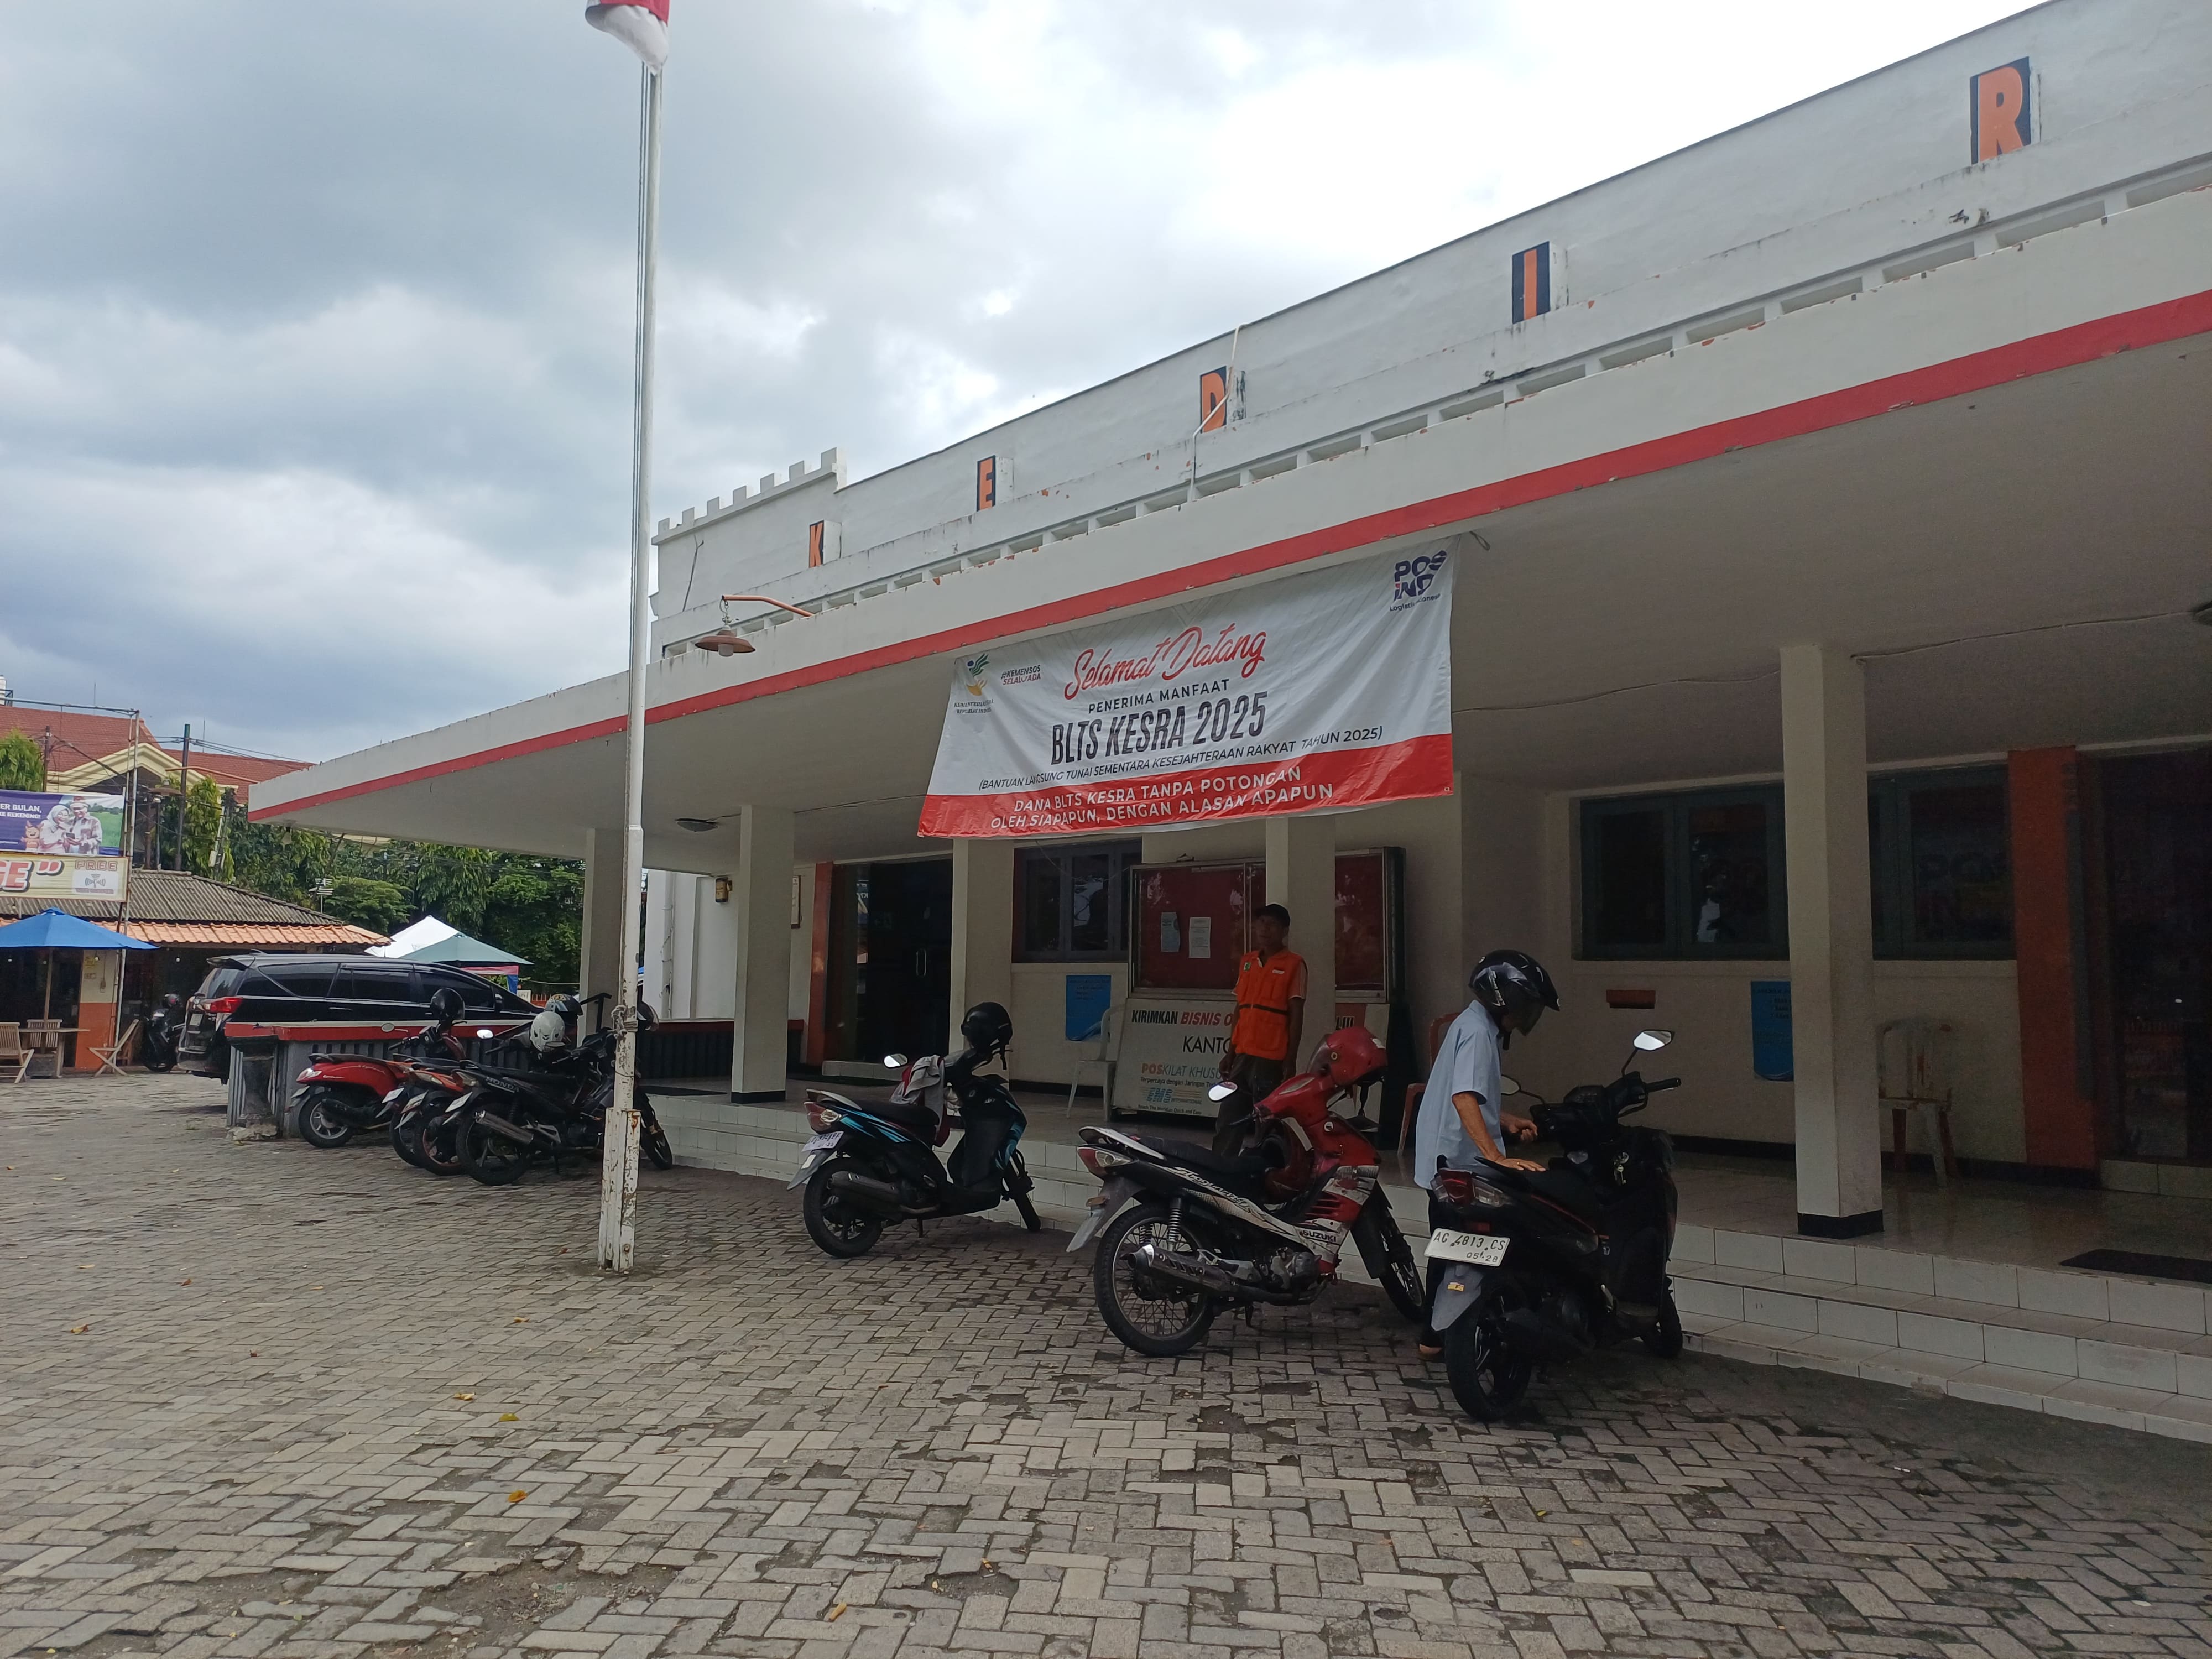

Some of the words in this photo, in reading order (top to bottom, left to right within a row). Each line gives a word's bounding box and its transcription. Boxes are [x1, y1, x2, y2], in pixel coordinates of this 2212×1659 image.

[1394, 550, 1447, 582] POS
[1000, 665, 1041, 680] #KEMENSOS
[1065, 637, 1171, 700] Selamat
[1162, 623, 1267, 681] Datang
[1089, 692, 1154, 714] PENERIMA
[1160, 679, 1229, 702] MANFAAT
[1051, 719, 1102, 765] BLTS
[1105, 706, 1186, 757] KESRA
[1193, 691, 1267, 745] 2025
[979, 776, 1024, 791] (BANTUAN
[1025, 771, 1065, 786] LANGSUNG
[1066, 768, 1092, 780] TUNAI
[1093, 760, 1151, 775] SEMENTARA
[1152, 747, 1244, 768] KESEJAHTERAAN
[1246, 741, 1296, 757] RAKYAT
[1301, 731, 1339, 750] TAHUN
[1343, 726, 1383, 742] 2025)
[1014, 799, 1051, 812] DANA
[1055, 792, 1082, 809] BLTS
[1087, 787, 1136, 805] KESRA
[1141, 780, 1194, 799] TANPA
[1201, 766, 1301, 793] POTONGAN
[12, 804, 42, 813] BULAN,
[990, 815, 1026, 828] OLEH
[1029, 809, 1100, 827] SIAPAPUN,
[1106, 801, 1172, 821] DENGAN
[1178, 794, 1246, 815] ALASAN
[1251, 783, 1333, 805] APAPUN
[75, 860, 118, 871] FREE
[1131, 1010, 1178, 1025] KIRIMKAN
[1180, 1011, 1221, 1026] BISNIS
[486, 1076, 520, 1092] HONDA
[1302, 1229, 1337, 1243] SUZUKI
[1433, 1232, 1449, 1244] AG
[1454, 1235, 1484, 1248] 4813
[1490, 1239, 1506, 1251] CS
